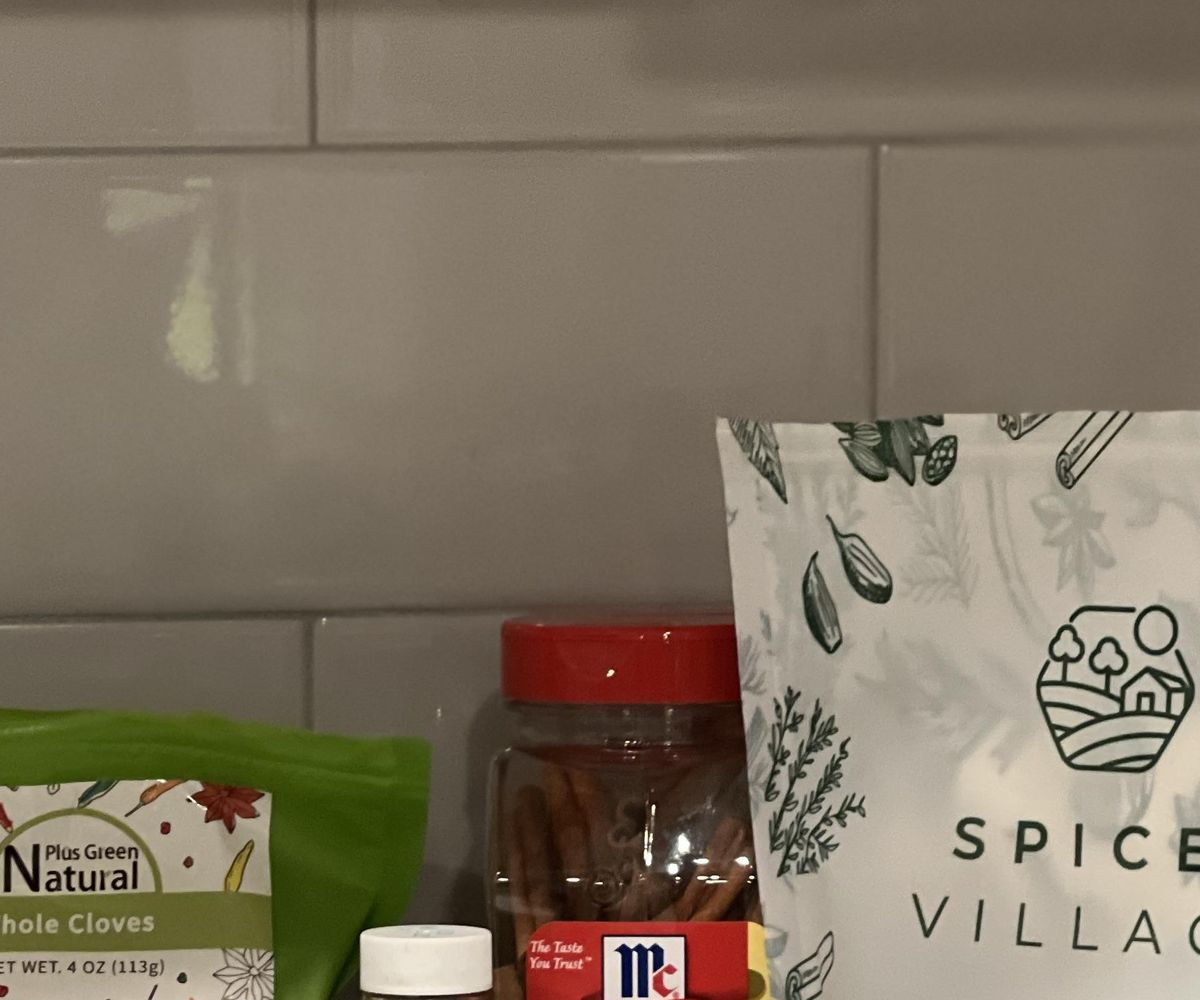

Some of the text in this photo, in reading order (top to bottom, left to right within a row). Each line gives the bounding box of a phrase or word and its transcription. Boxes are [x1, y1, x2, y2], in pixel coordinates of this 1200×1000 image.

[45, 843, 140, 861] Plus Green
[952, 816, 1200, 873] SPICE
[68, 912, 155, 934] Cloves
[911, 892, 1200, 956] VILLA
[530, 939, 584, 954] The Taste
[21, 960, 62, 974] WET.
[67, 961, 77, 974] 4
[82, 960, 106, 974] OZ
[111, 959, 165, 977] (113g)
[529, 956, 550, 970] You
